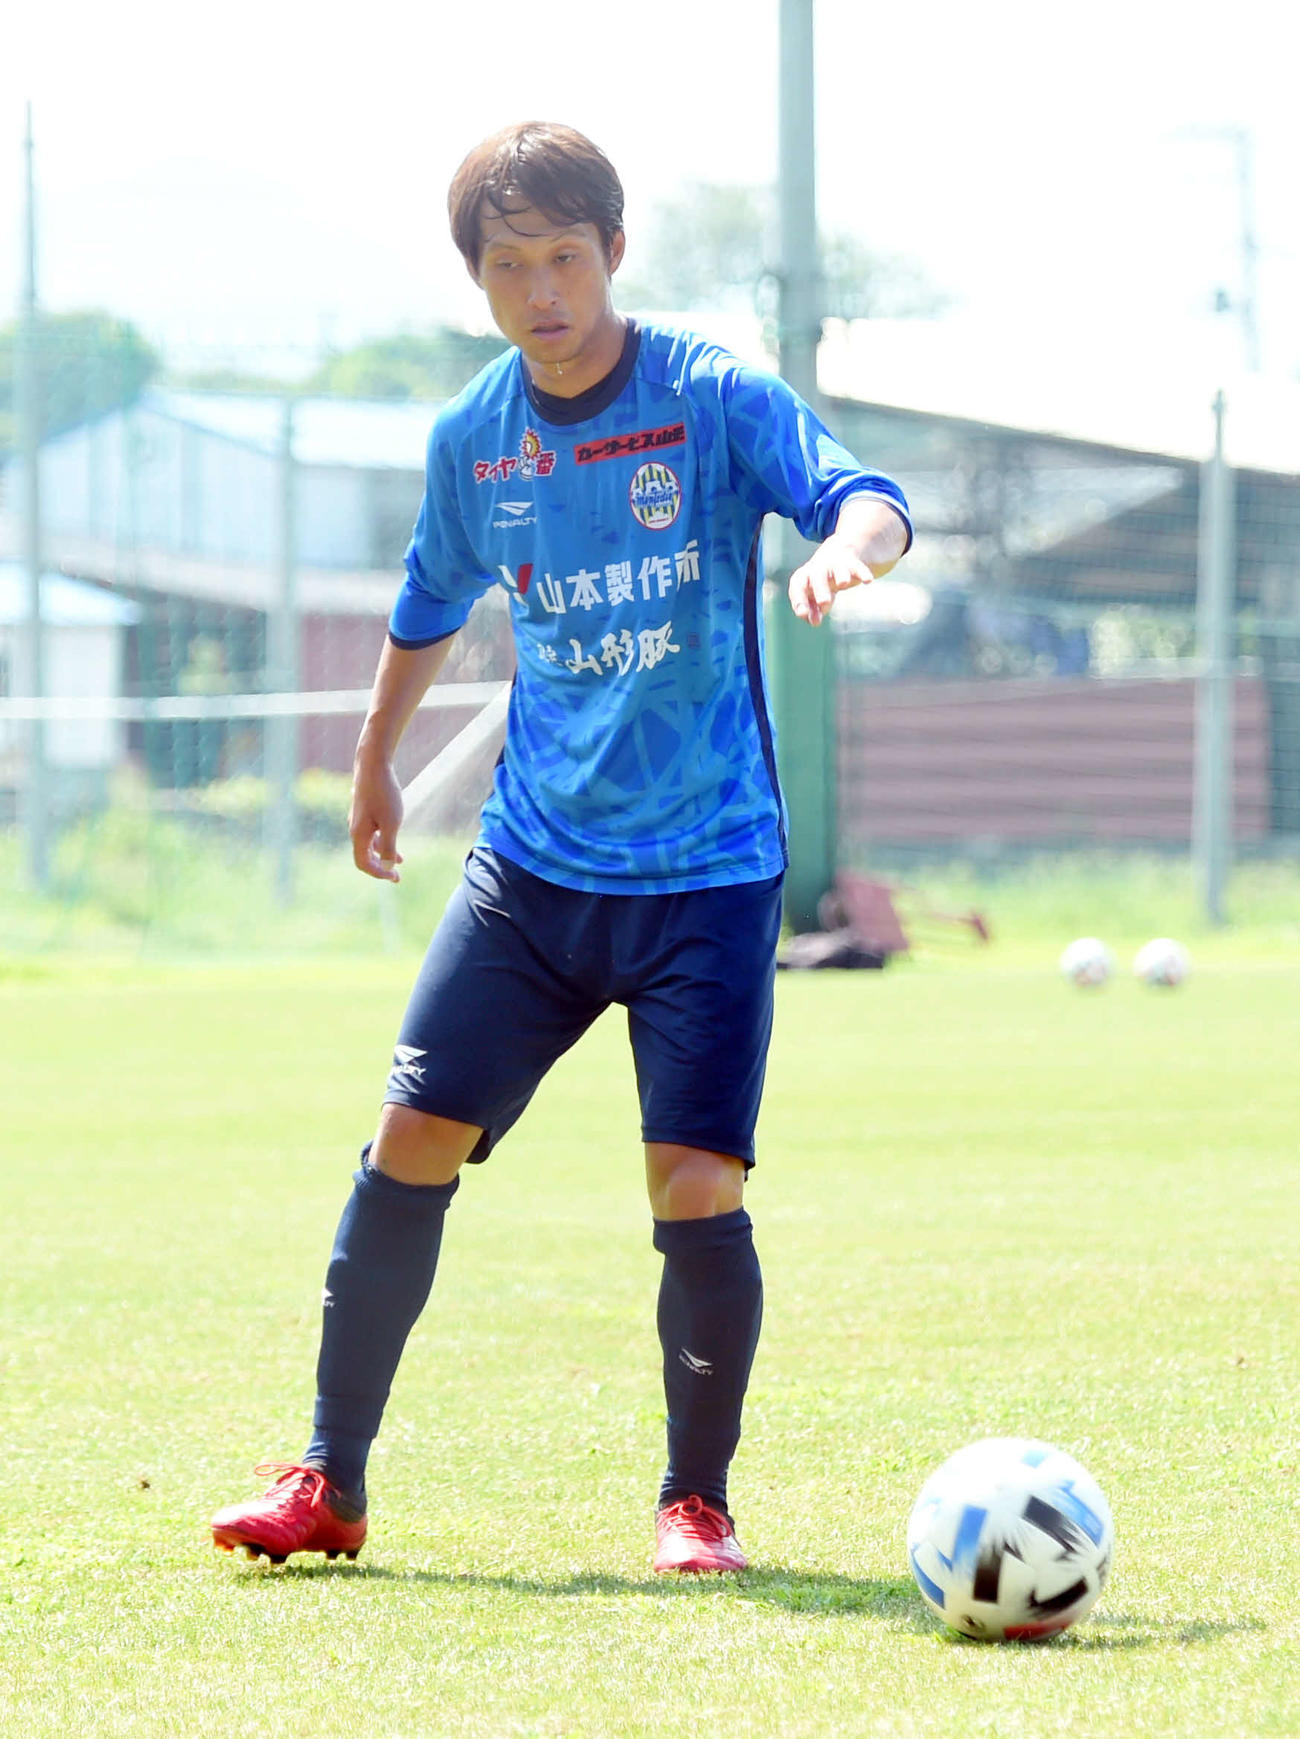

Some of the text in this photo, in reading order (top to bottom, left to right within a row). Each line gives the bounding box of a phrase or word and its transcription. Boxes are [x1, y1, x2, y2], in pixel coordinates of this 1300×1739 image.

[493, 516, 538, 529] PENALTY
[536, 539, 701, 615] 山本製作所
